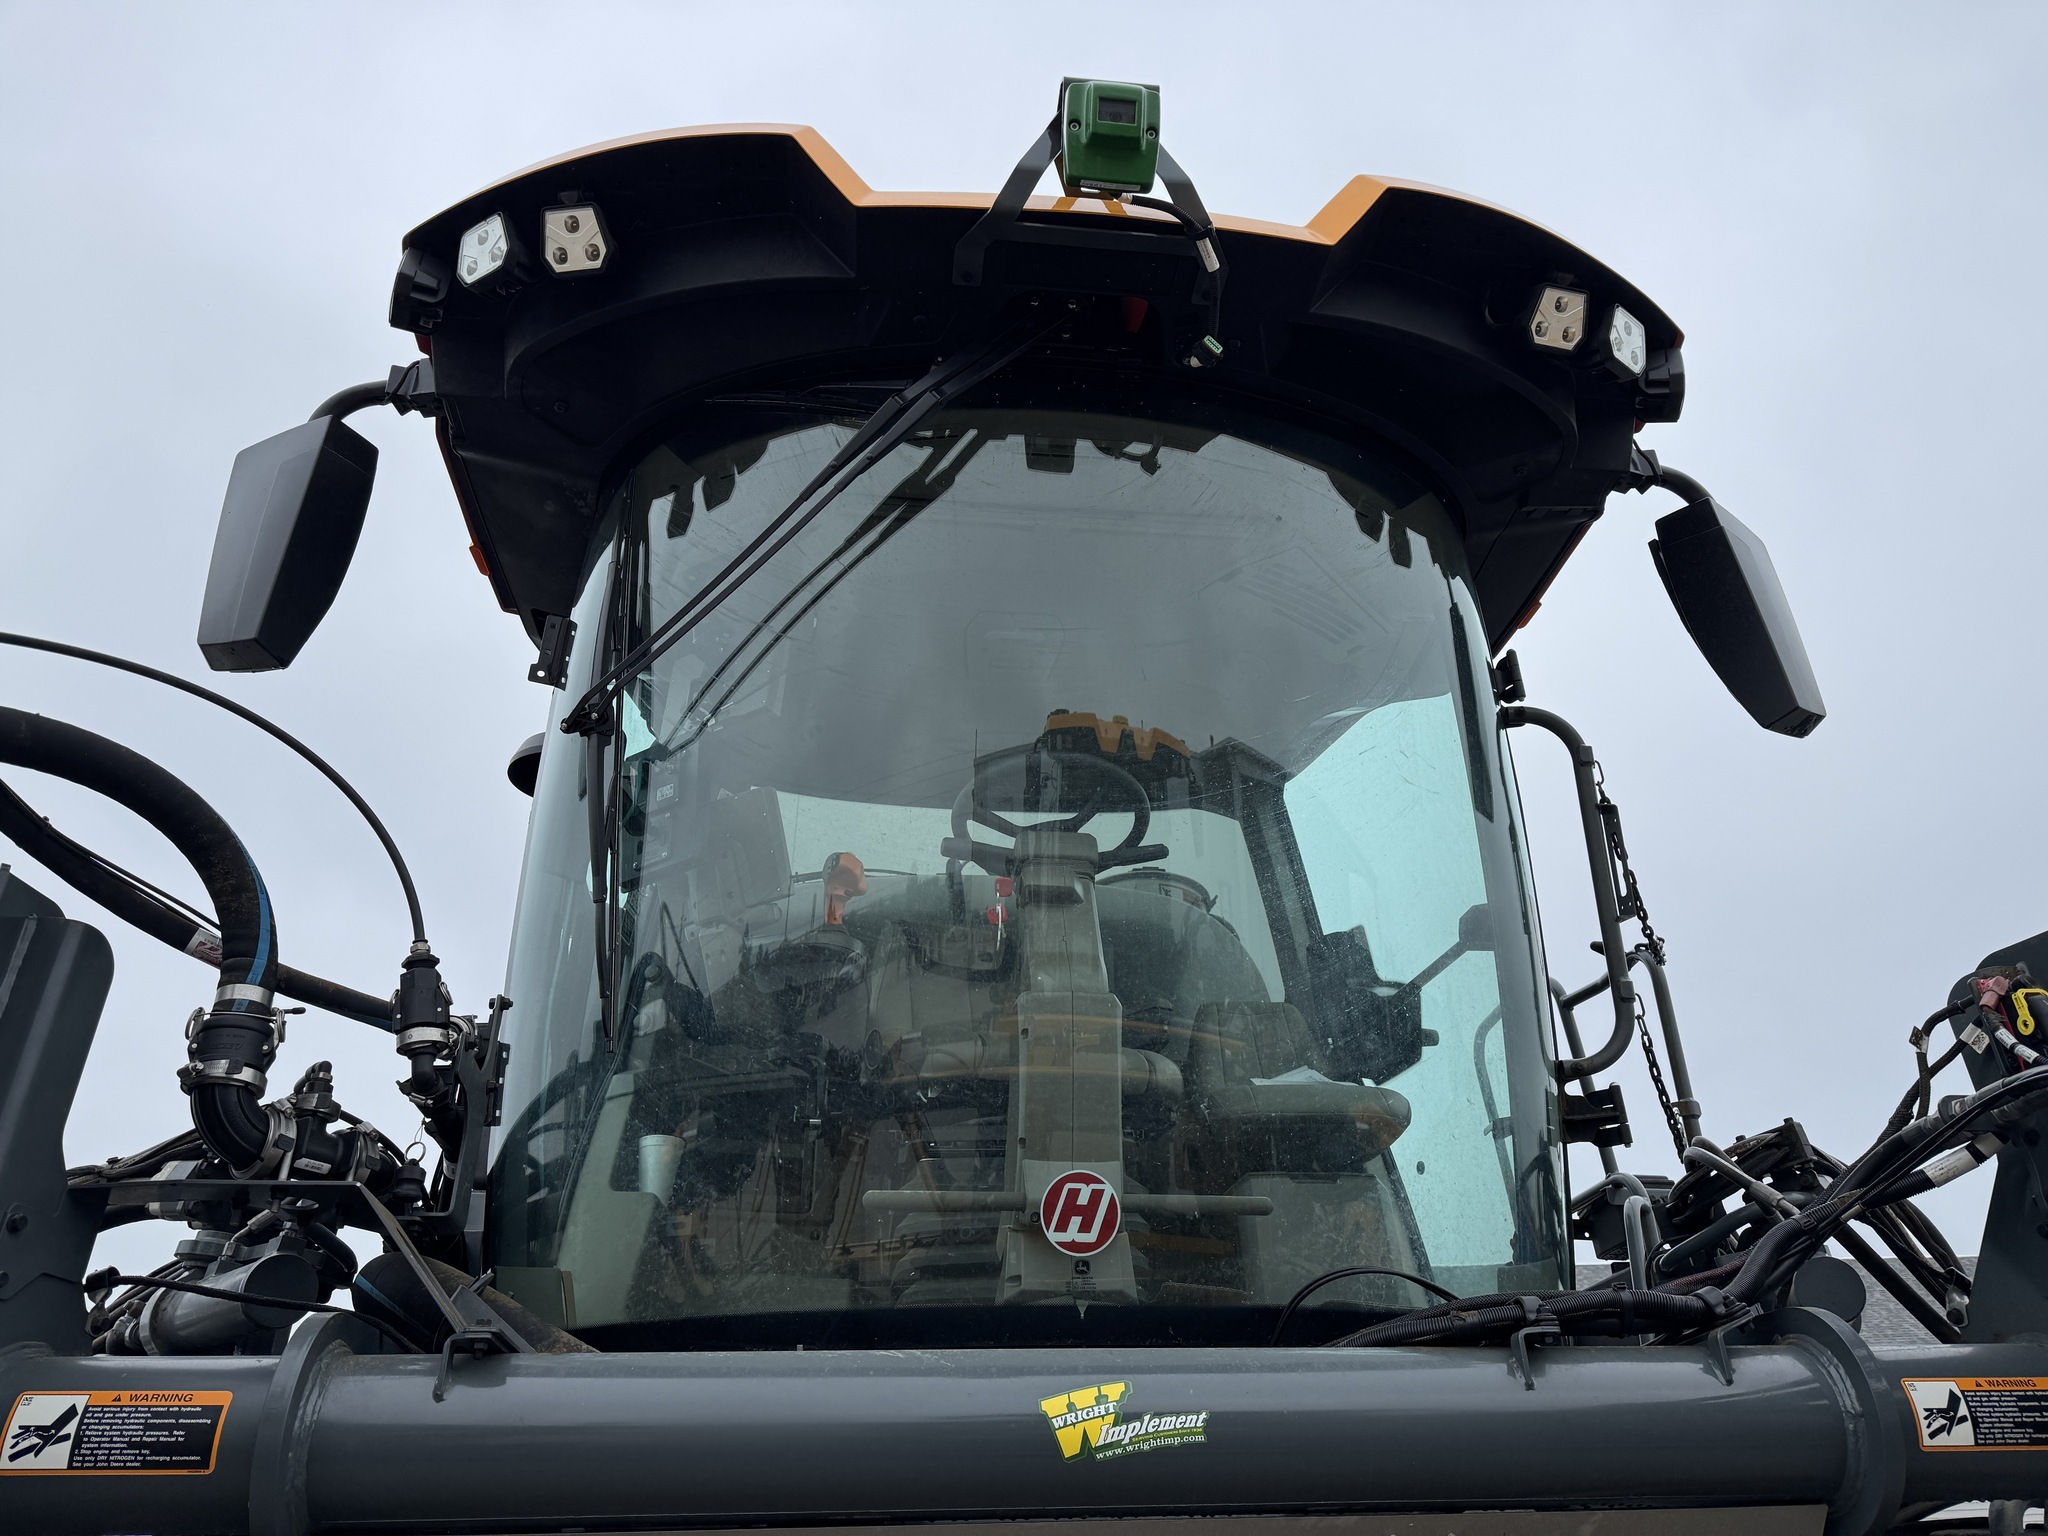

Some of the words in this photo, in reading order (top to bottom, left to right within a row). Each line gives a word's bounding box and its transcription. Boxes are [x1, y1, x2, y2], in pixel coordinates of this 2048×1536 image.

[1984, 1379, 2037, 1387] WARNING
[129, 1394, 194, 1402] WARNING
[1051, 1401, 1117, 1429] WRIGHT
[1095, 1411, 1208, 1447] Implement
[1096, 1434, 1206, 1460] www.wrightimp.com
